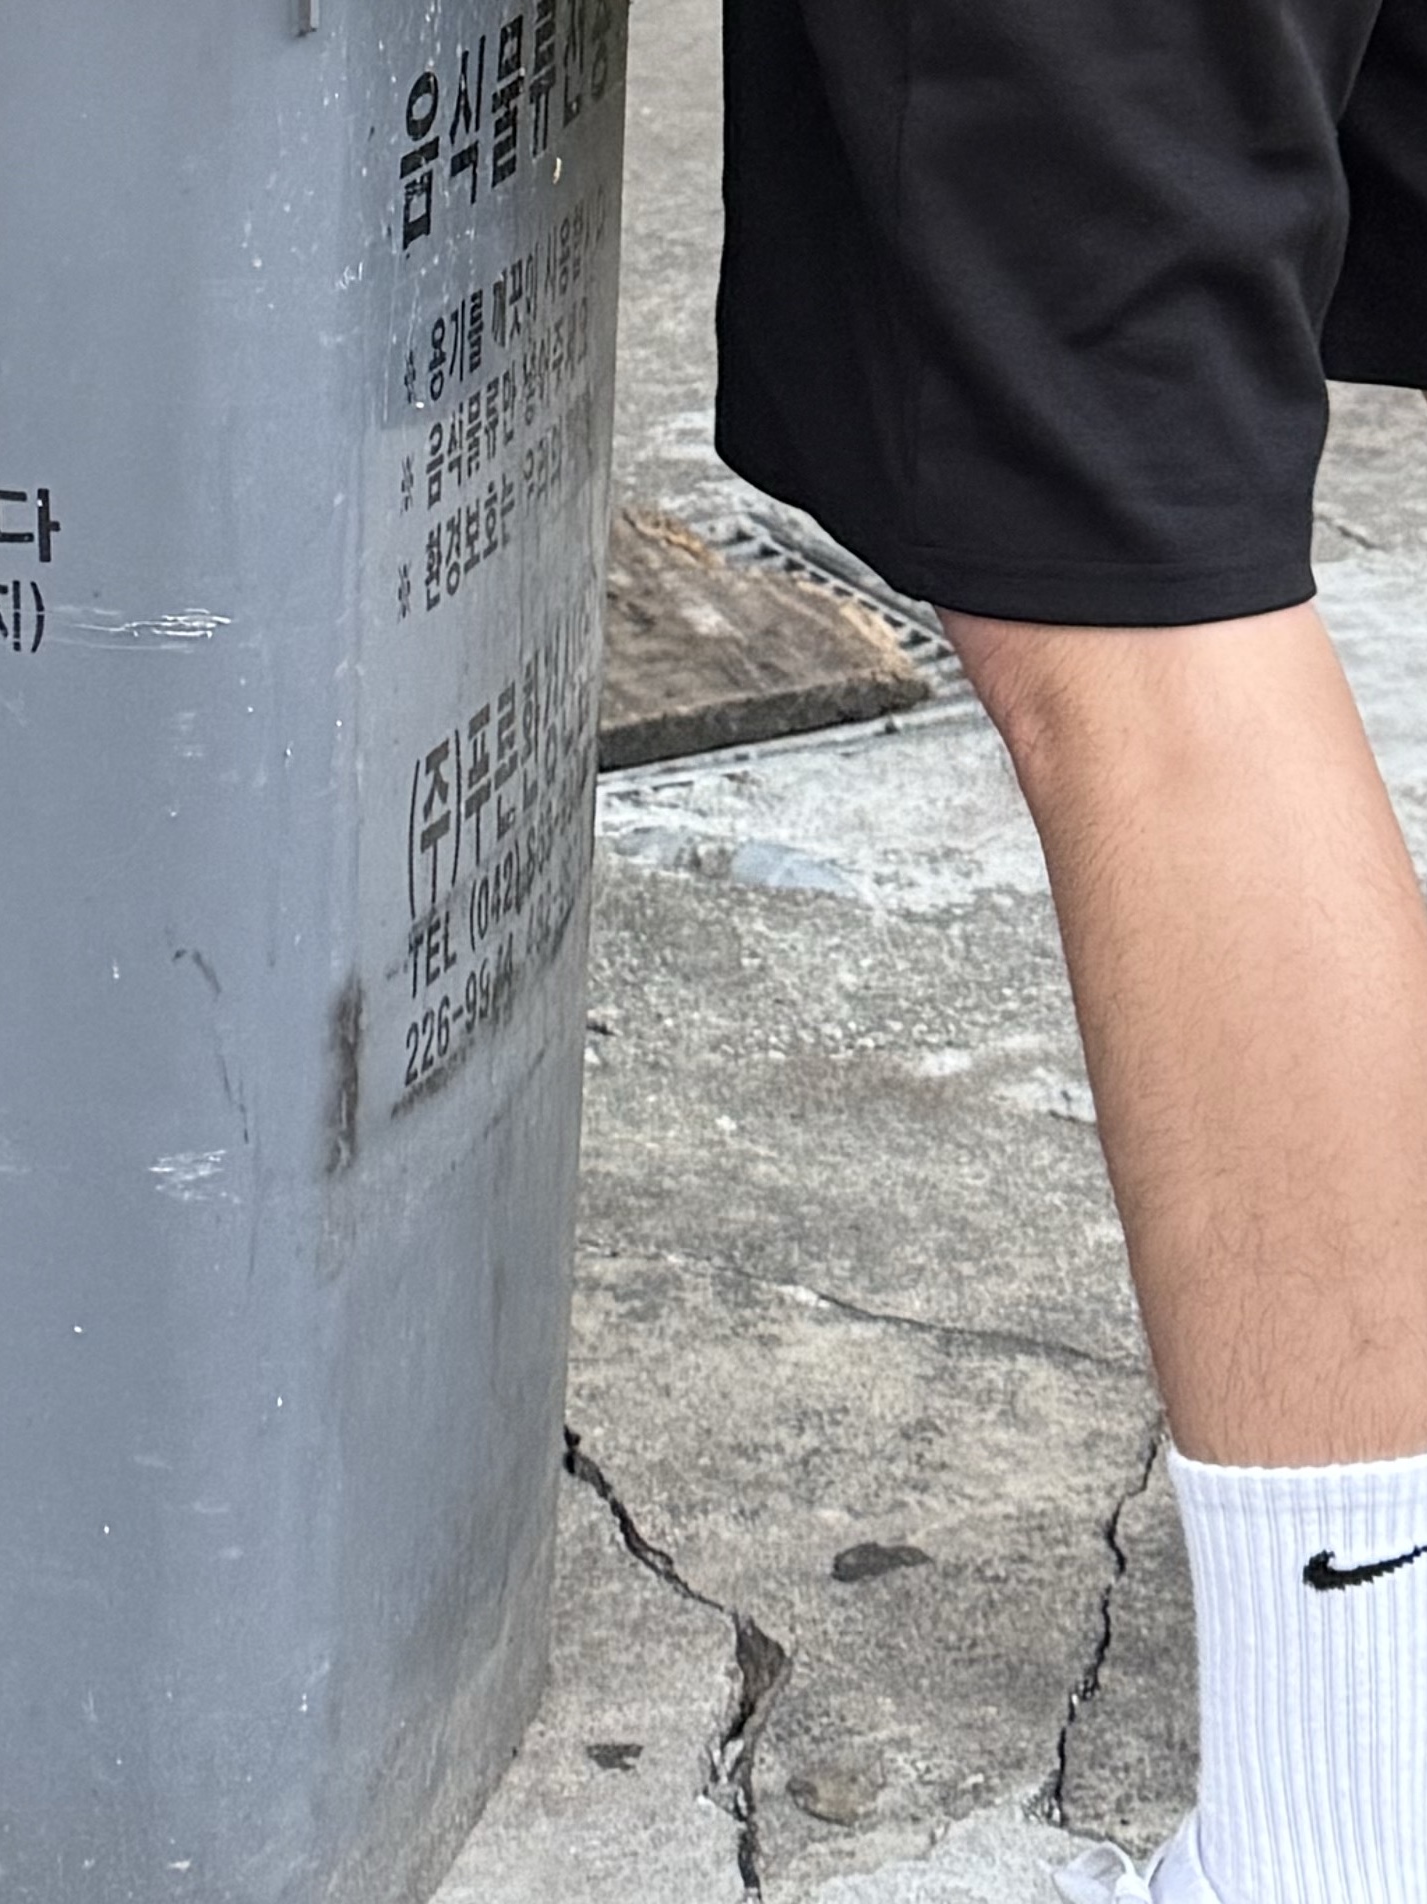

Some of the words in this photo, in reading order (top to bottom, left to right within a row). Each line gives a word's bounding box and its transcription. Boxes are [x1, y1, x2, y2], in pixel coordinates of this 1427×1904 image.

[428, 289, 484, 402] 용기를
[426, 361, 517, 510] 음식물류만
[408, 911, 457, 998] TEL
